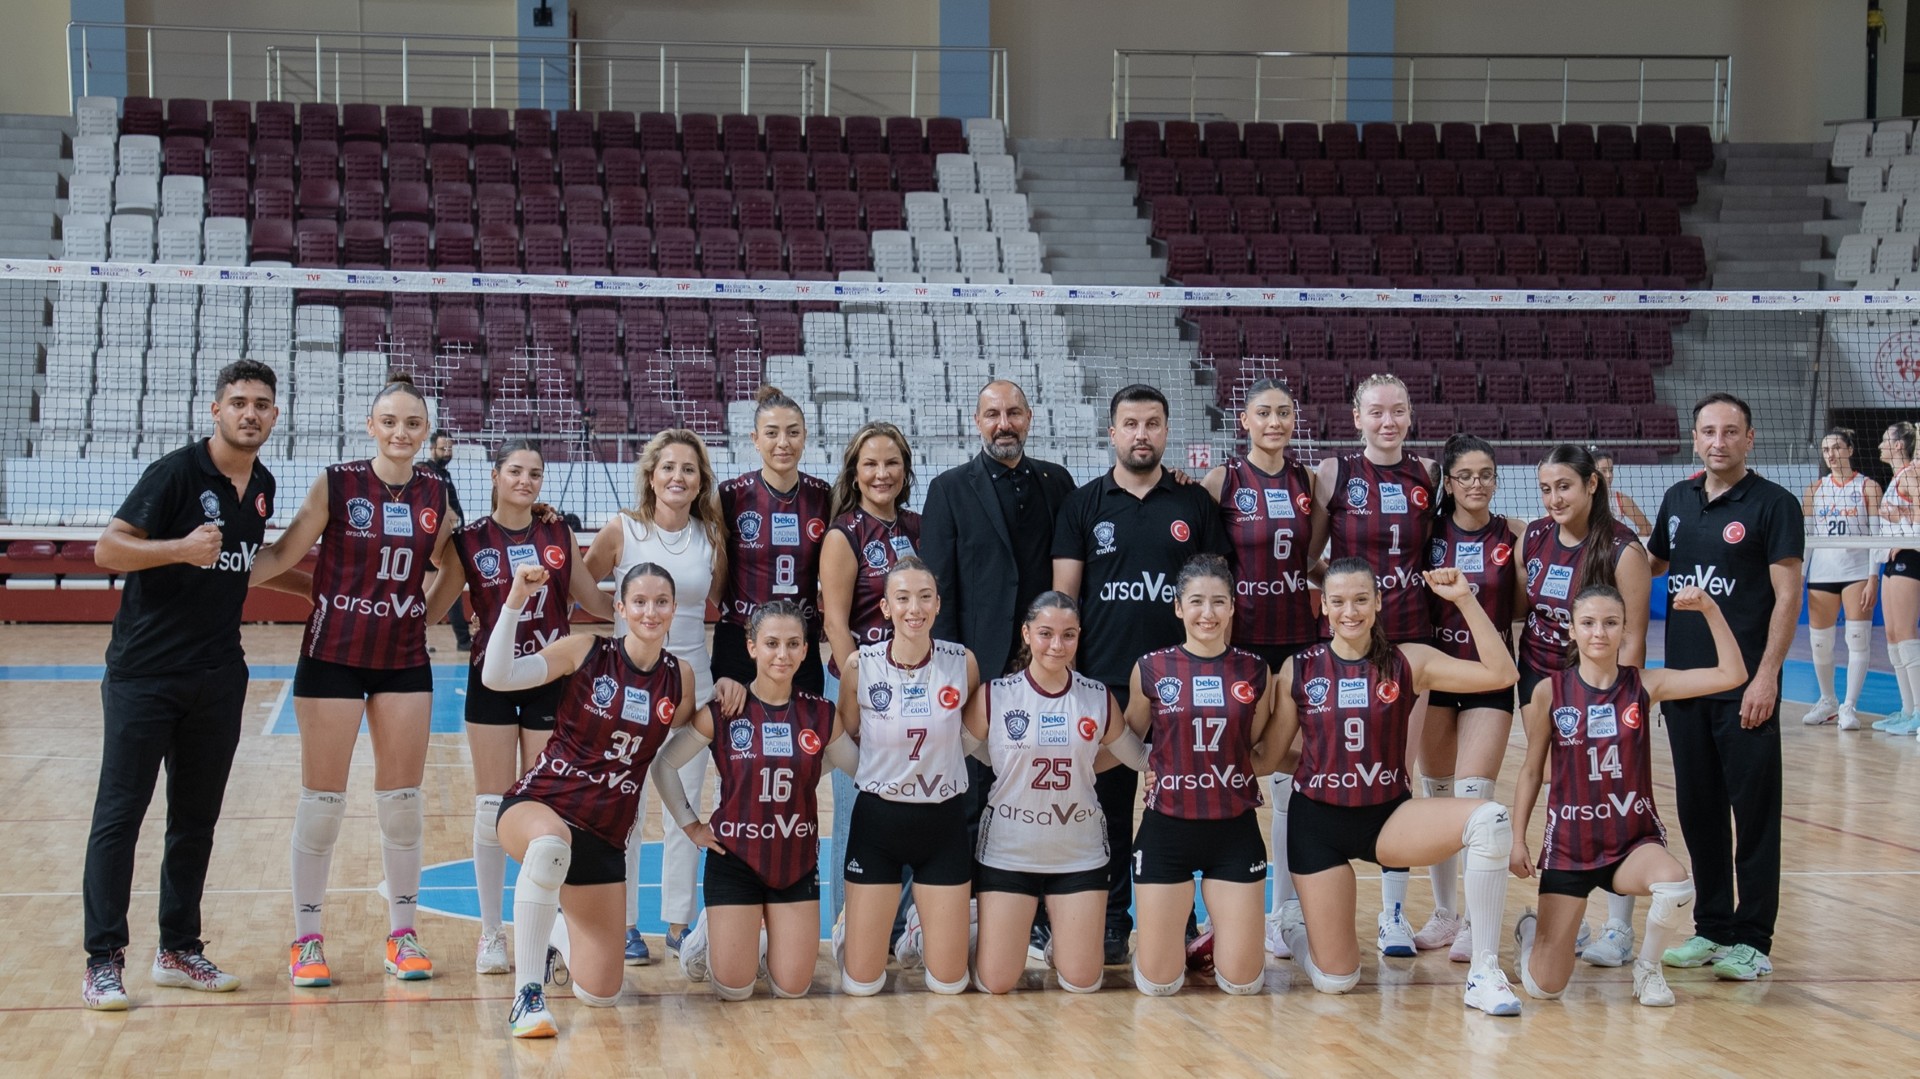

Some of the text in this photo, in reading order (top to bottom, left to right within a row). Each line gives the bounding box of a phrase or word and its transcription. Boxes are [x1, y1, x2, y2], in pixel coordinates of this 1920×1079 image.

[385, 505, 408, 515] beko
[1388, 524, 1401, 555] 1
[1828, 520, 1846, 535] 20
[510, 547, 534, 557] beko
[1274, 528, 1293, 560] 6
[376, 546, 414, 582] 10
[776, 554, 795, 586] 8
[1550, 566, 1570, 577] beko
[333, 593, 426, 618] arsaVev
[904, 686, 926, 695] beko
[1196, 678, 1220, 687] beko
[627, 690, 647, 702] beko
[764, 725, 789, 734] beko
[1042, 715, 1065, 723] beko
[907, 728, 927, 761] 7
[1192, 717, 1227, 752] 17
[1344, 717, 1364, 751] 9
[604, 730, 644, 766] 31
[1031, 758, 1072, 790] 25
[1309, 762, 1398, 788] arsaVev
[1587, 745, 1622, 781] 14
[759, 767, 794, 802] 16
[865, 774, 957, 798] arsaVev
[1161, 765, 1254, 790] arsaVev
[720, 814, 815, 839] arsaVev
[999, 803, 1097, 826] arsaVev
